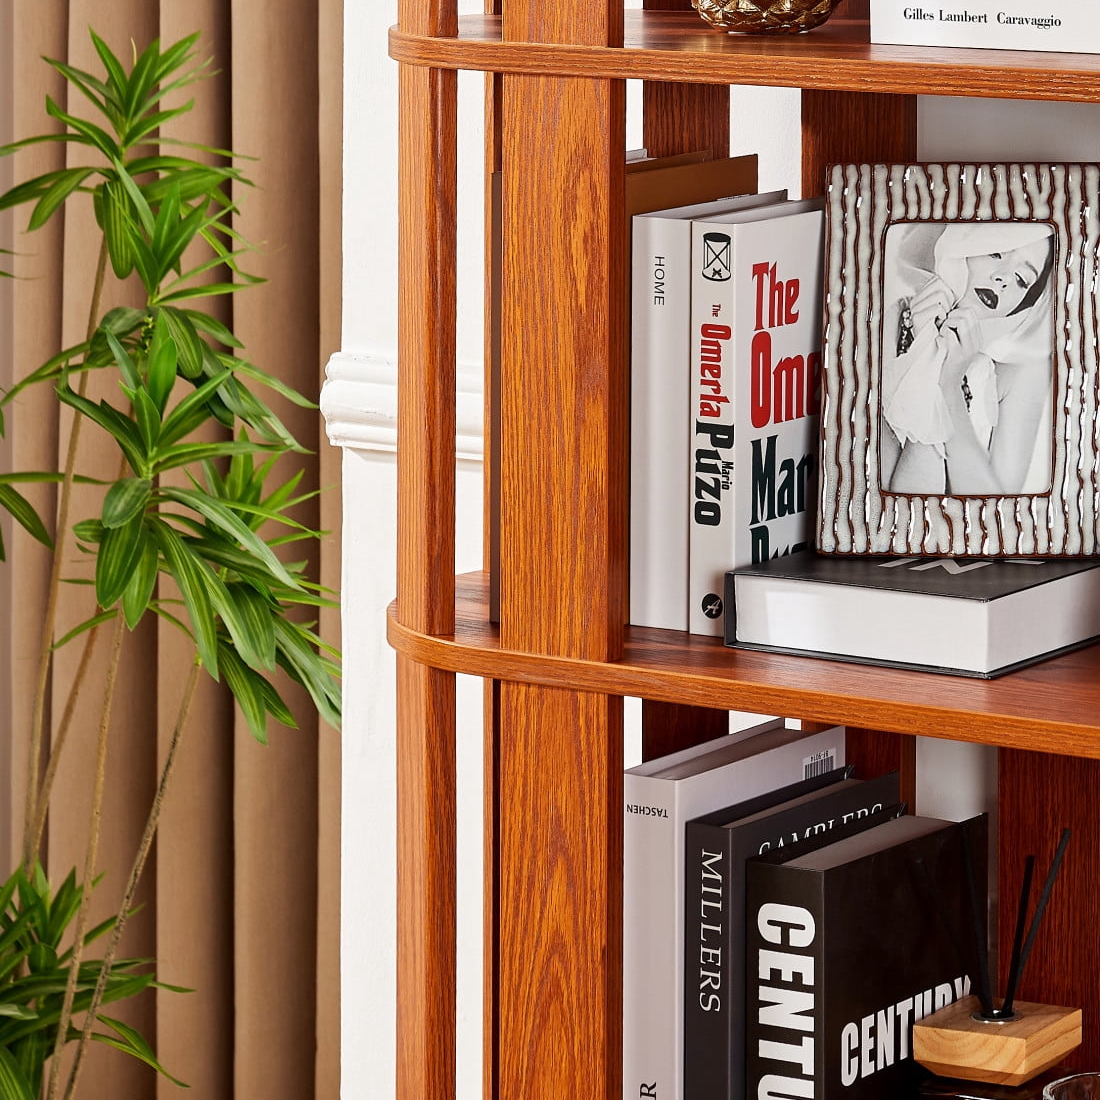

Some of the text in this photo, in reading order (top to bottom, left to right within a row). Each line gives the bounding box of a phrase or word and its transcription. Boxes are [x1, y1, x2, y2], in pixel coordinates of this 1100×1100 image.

[903, 7, 1062, 29] Gilles Lambert Caravaggio
[653, 256, 665, 306] HOME
[752, 261, 800, 331] The
[700, 303, 732, 418] The Omerta
[694, 418, 735, 527] Puzo
[721, 461, 734, 491] Mario
[626, 803, 669, 818] TASCHEN
[700, 849, 723, 1013] MILLERS
